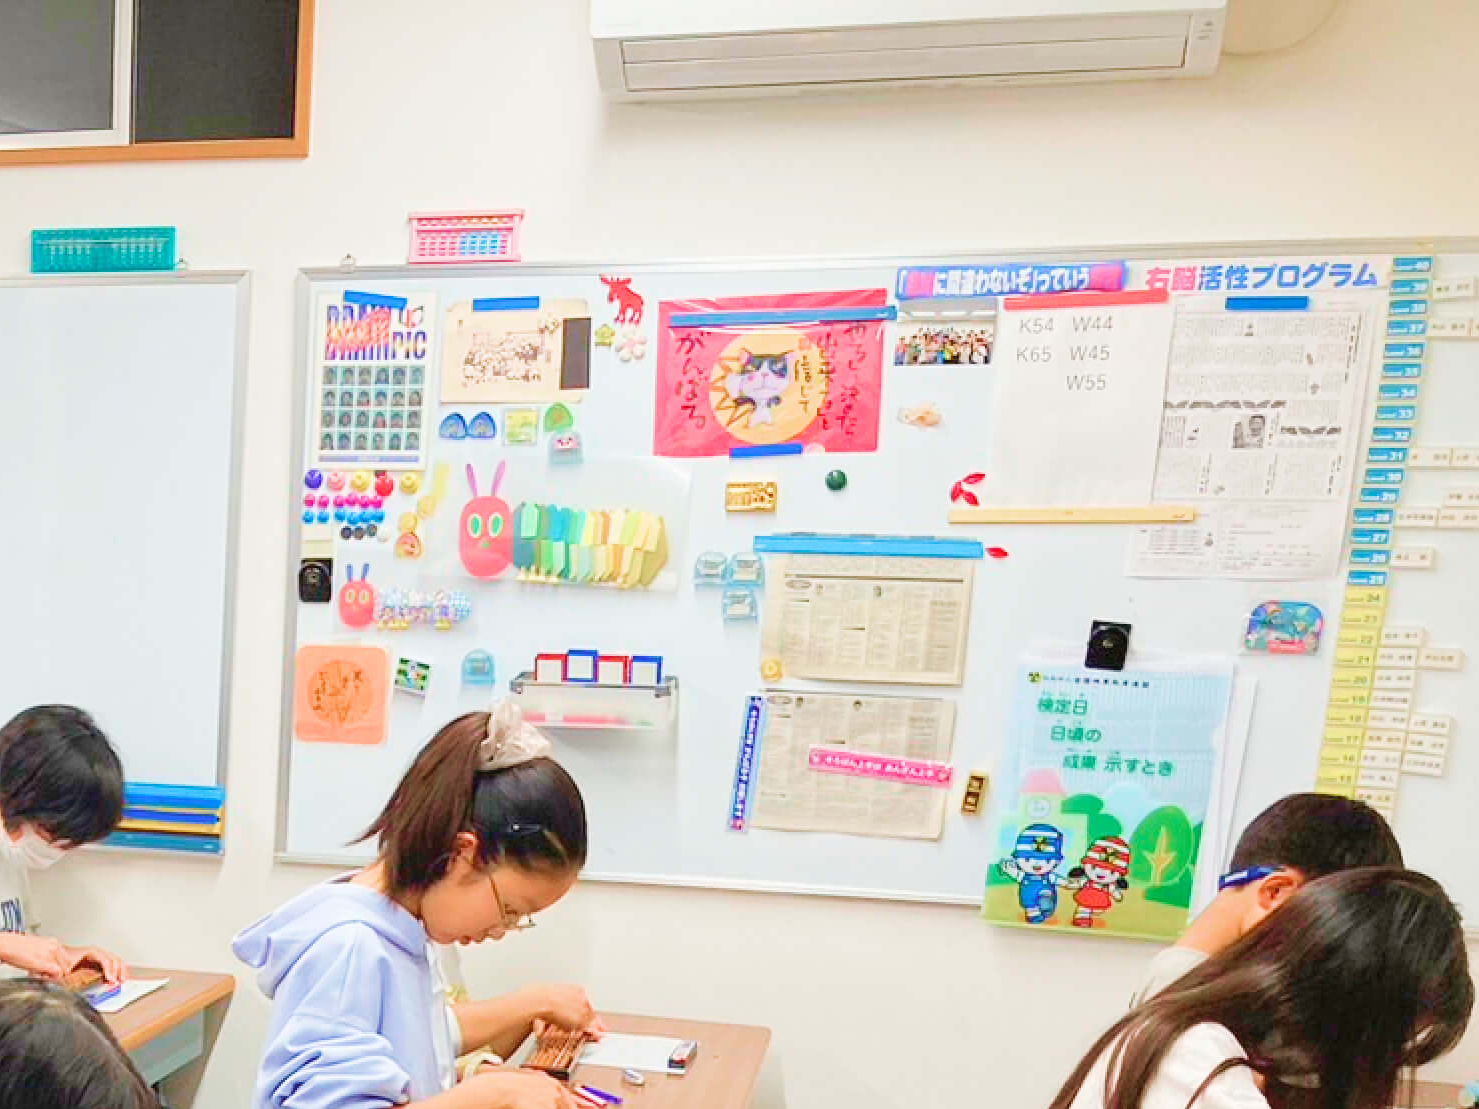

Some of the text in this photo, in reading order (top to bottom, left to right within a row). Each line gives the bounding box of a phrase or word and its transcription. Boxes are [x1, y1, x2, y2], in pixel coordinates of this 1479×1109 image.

[1146, 262, 1378, 291] 右脳活性プログラム
[1019, 315, 1113, 334] K54 W44
[1016, 344, 1110, 362] K65 W45
[1066, 373, 1106, 390] W55
[1037, 697, 1089, 716] 検定日
[1104, 755, 1175, 777] 示すとき
